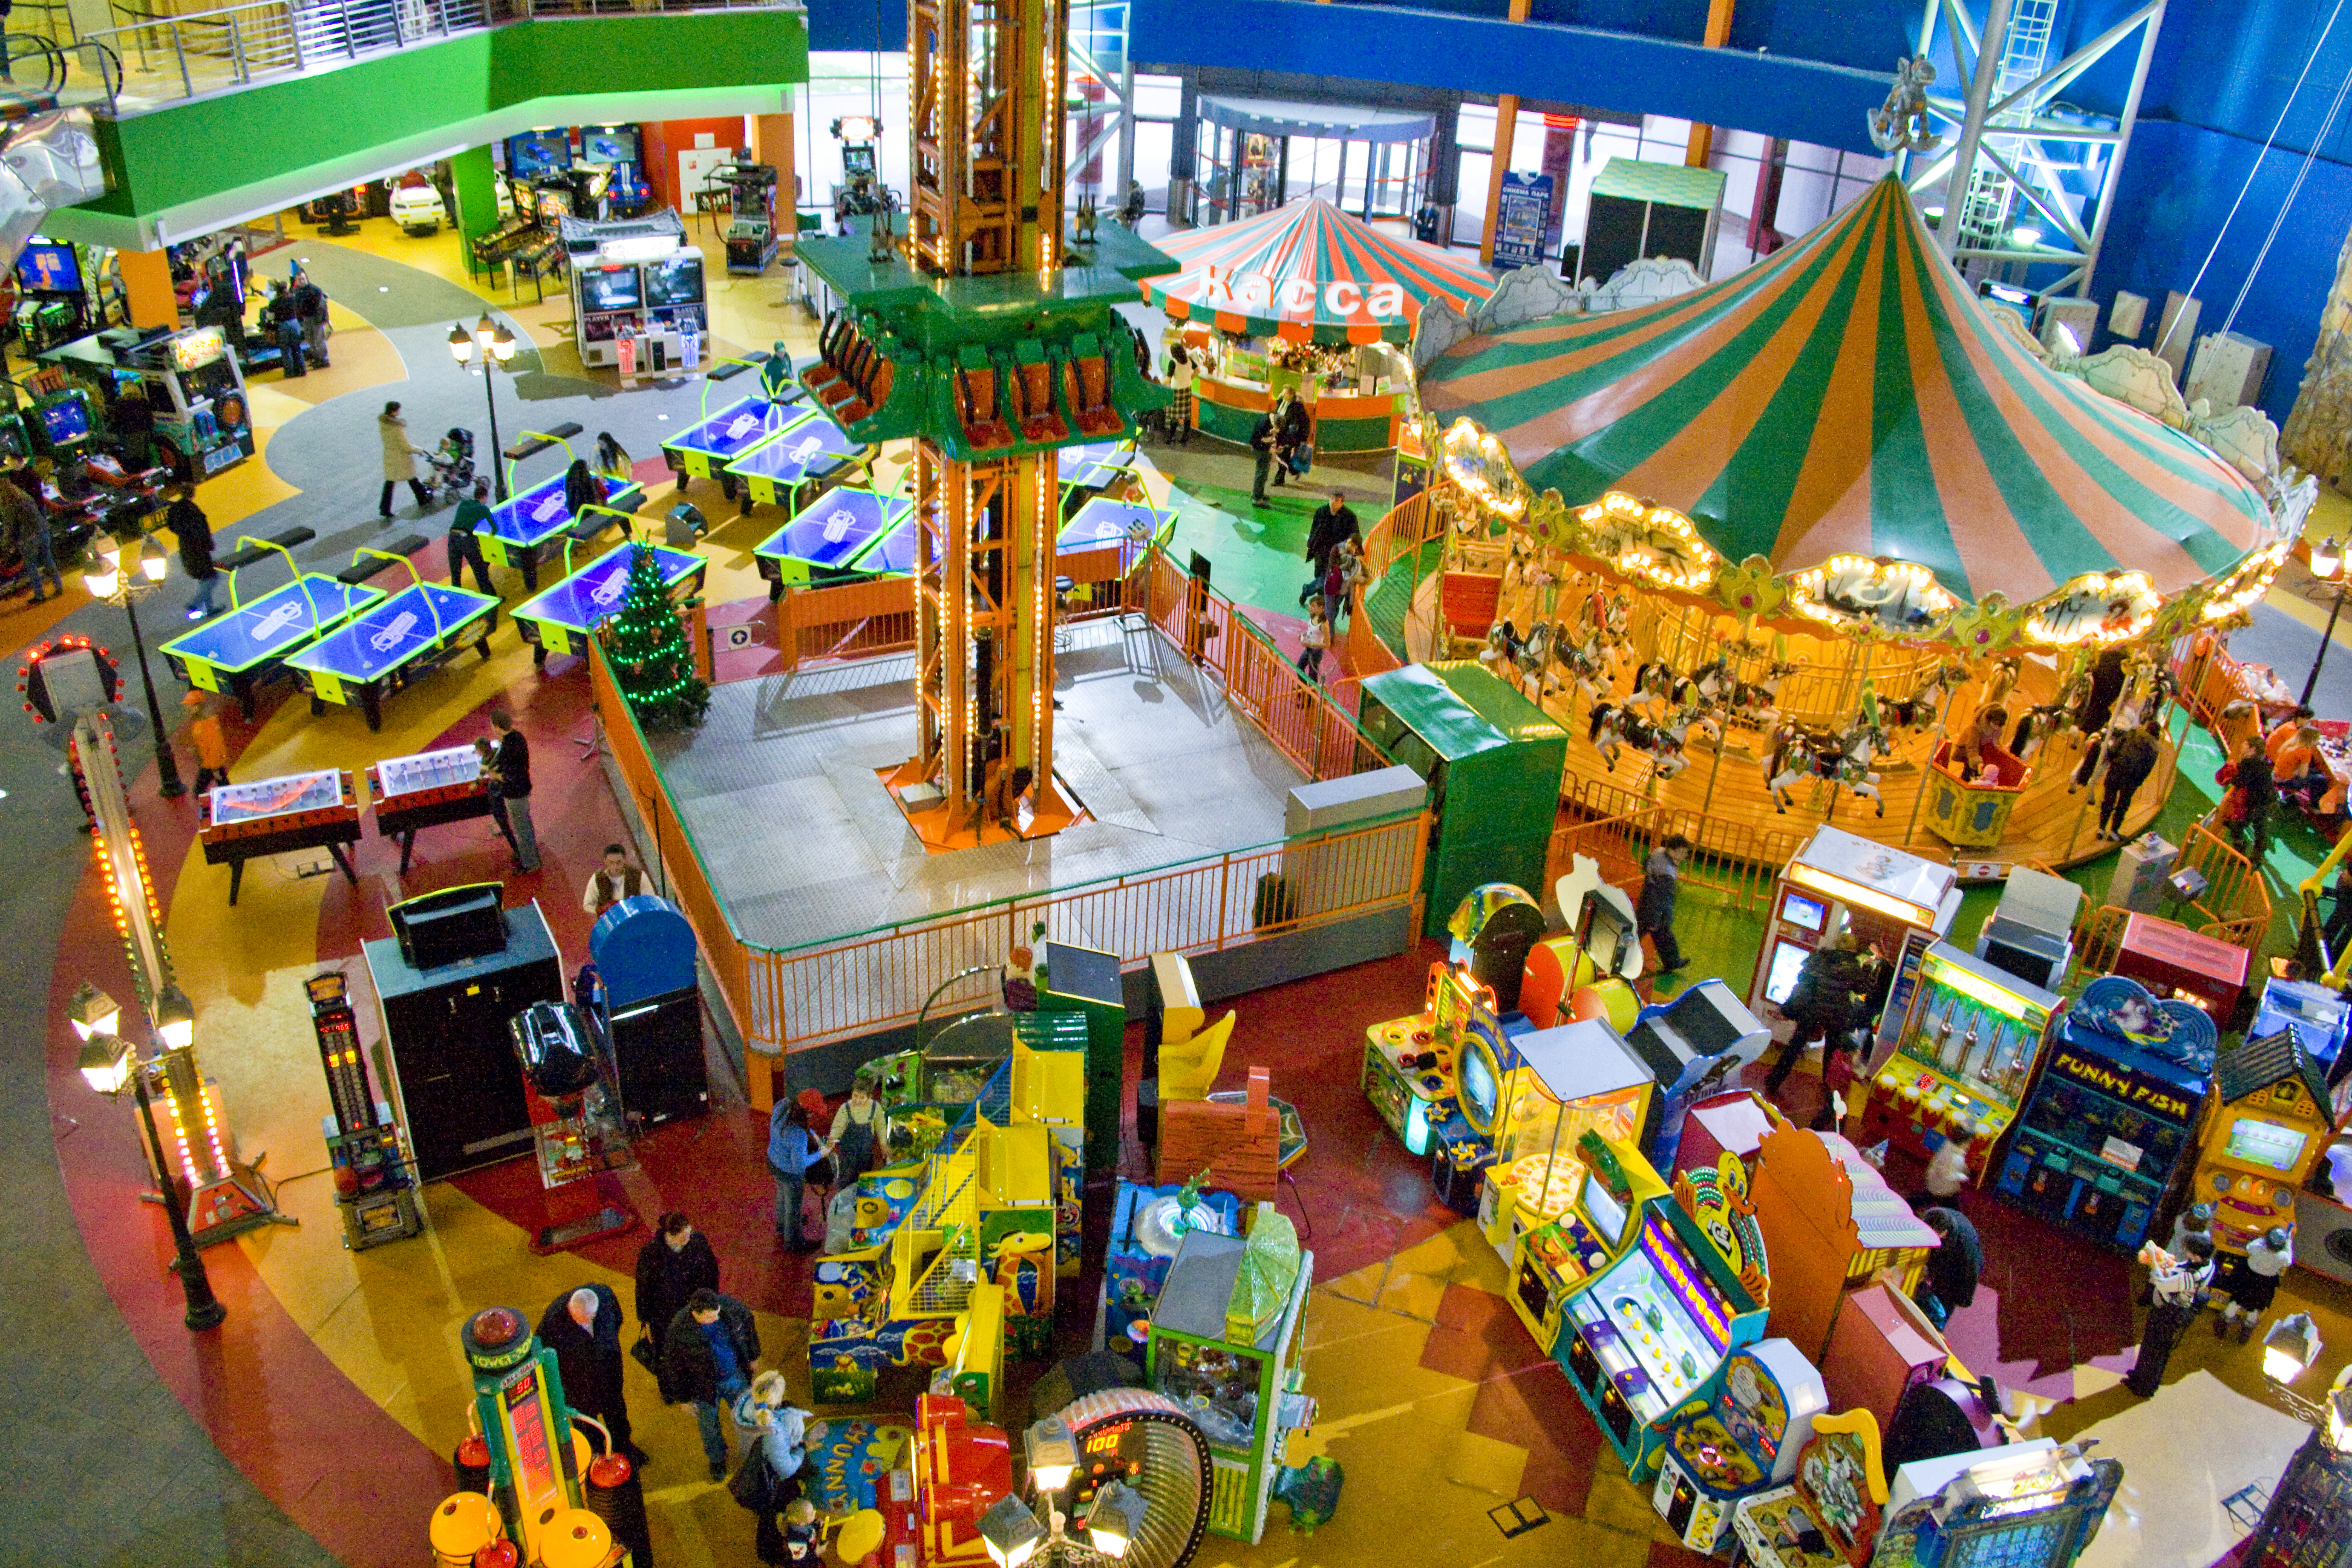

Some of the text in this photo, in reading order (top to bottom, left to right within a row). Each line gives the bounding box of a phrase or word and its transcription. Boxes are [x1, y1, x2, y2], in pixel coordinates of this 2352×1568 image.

[204, 442, 243, 474] SEGA
[2055, 1053, 2188, 1118] FUNNY FISH
[1707, 1218, 1731, 1252] ICE
[1645, 1223, 1731, 1345] WACKY DUCKS
[516, 1376, 532, 1395] 50
[1086, 1433, 1119, 1454] 100
